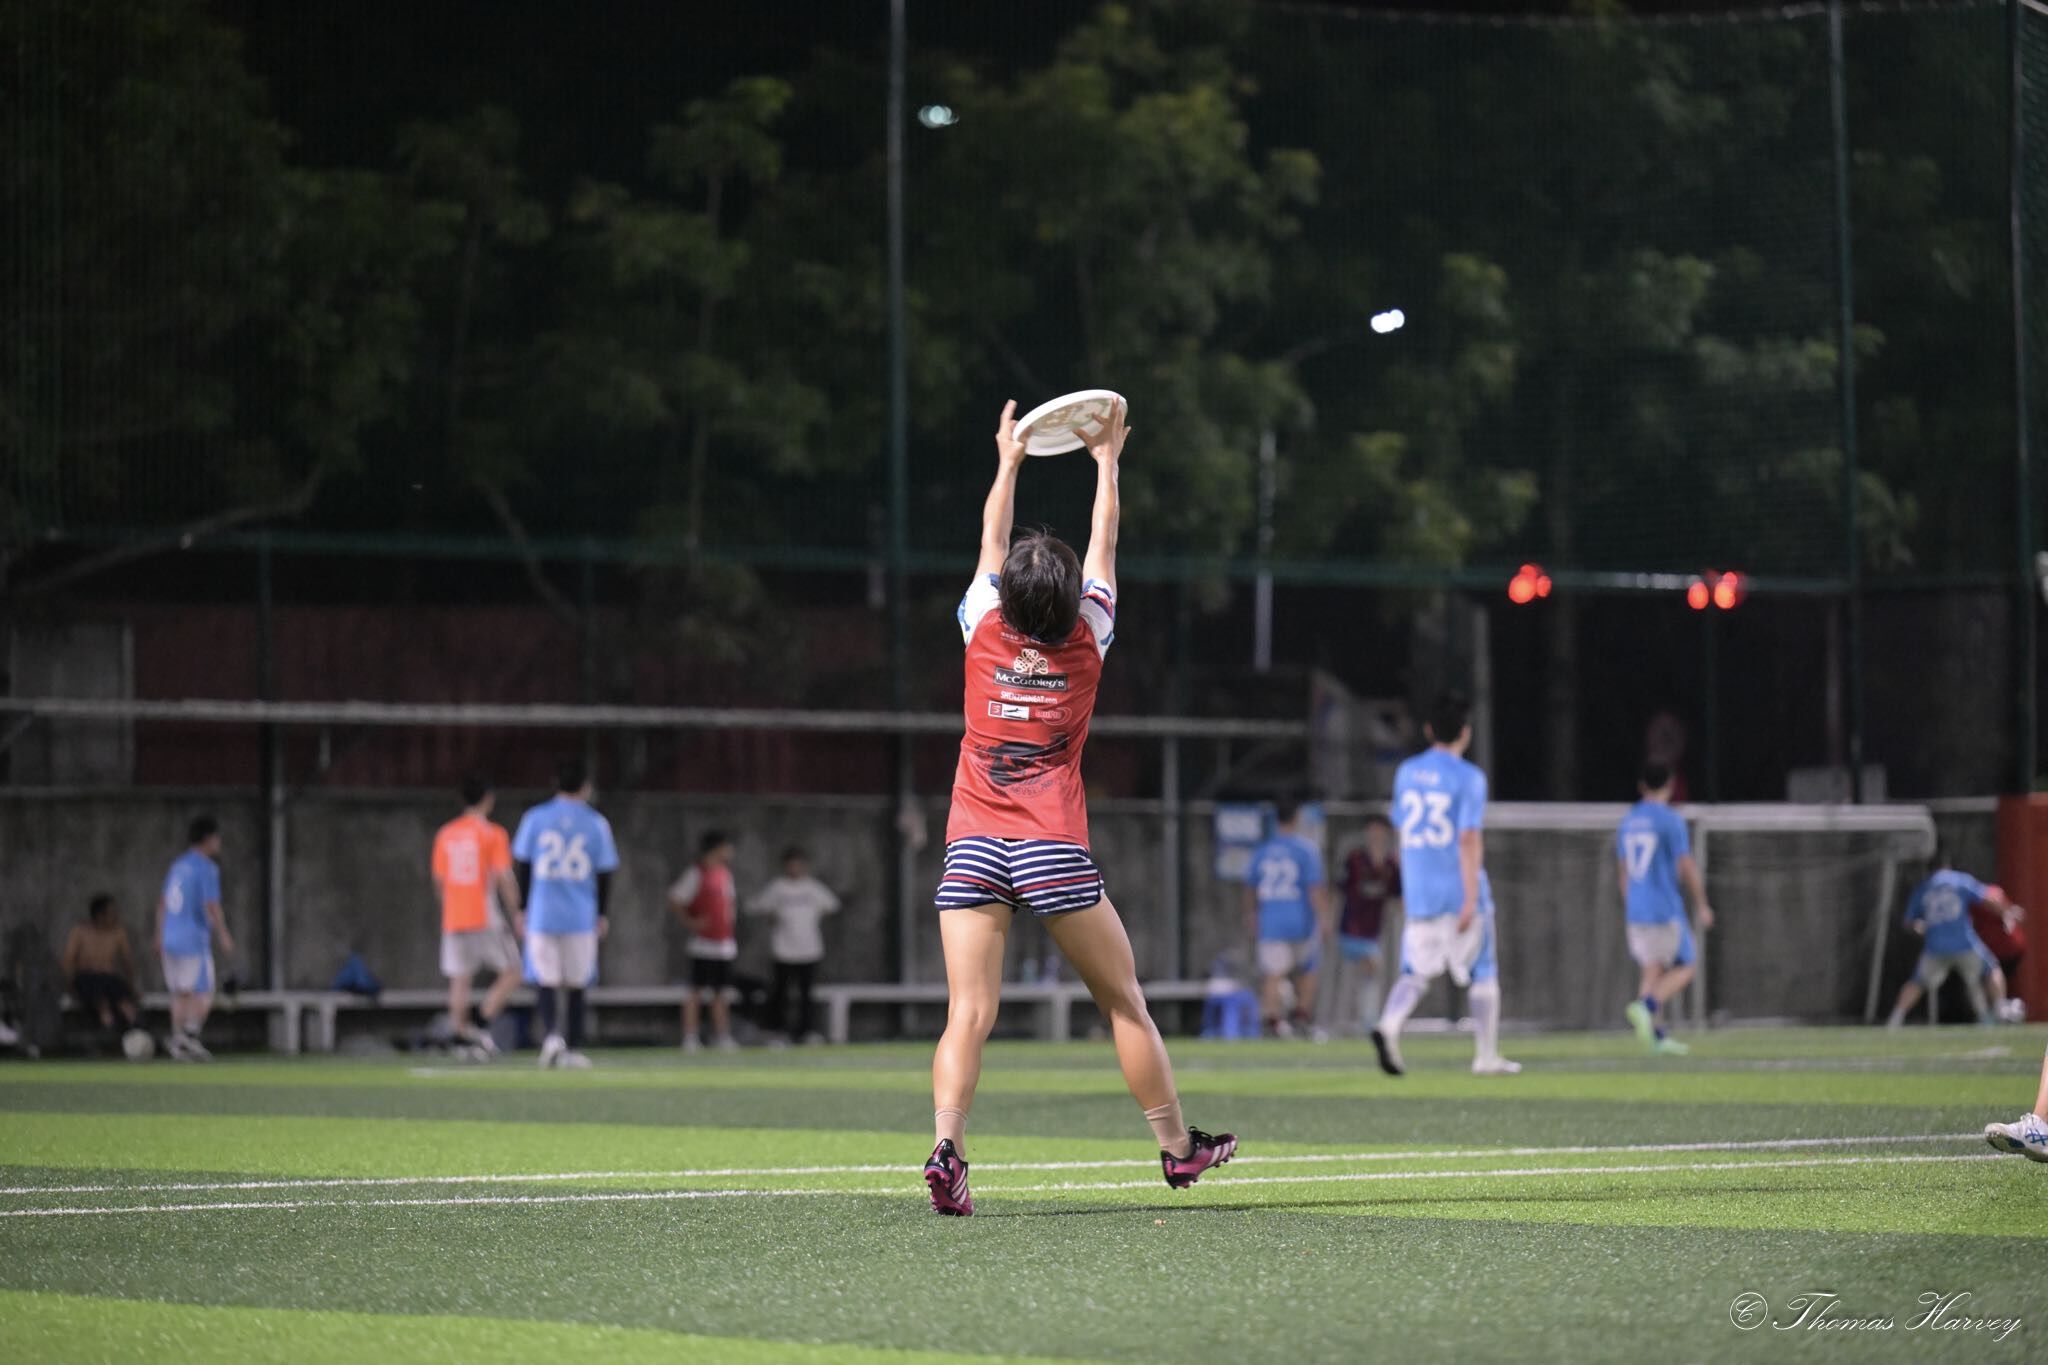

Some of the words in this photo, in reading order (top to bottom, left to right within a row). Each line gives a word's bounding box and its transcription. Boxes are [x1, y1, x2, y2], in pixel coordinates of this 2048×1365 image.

[1401, 789, 1454, 848] 23
[536, 829, 592, 881] 26
[1257, 858, 1301, 901] 22
[1623, 832, 1658, 881] 17
